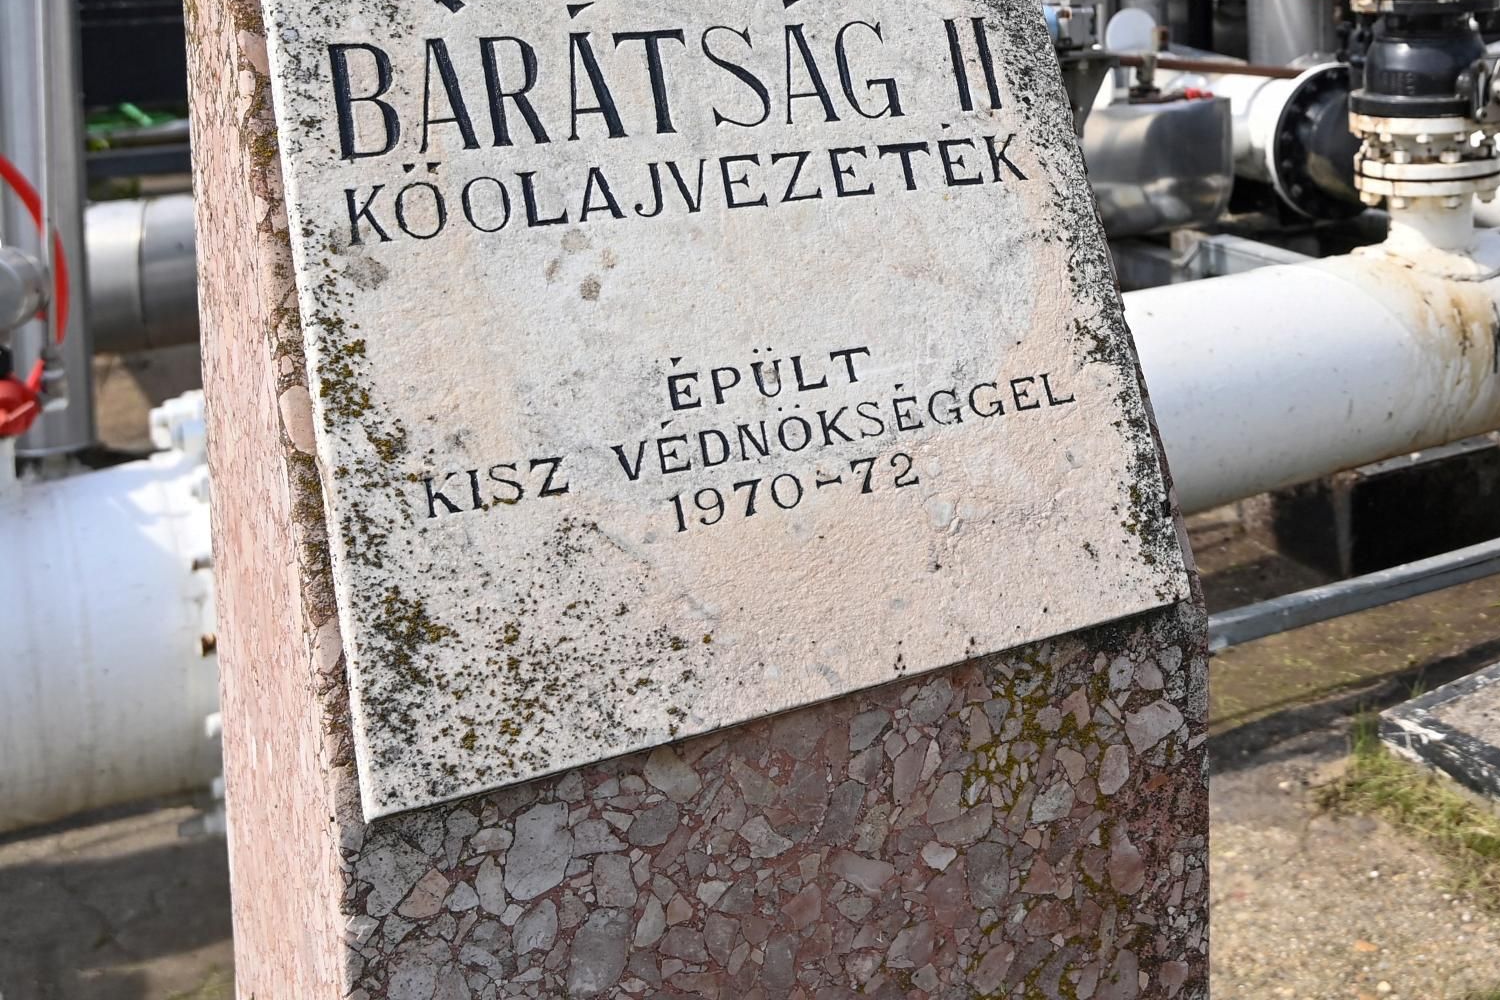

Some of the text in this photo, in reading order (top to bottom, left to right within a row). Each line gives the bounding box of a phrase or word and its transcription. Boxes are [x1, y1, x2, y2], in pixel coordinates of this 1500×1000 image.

[943, 16, 1002, 112] II
[344, 122, 1029, 246] KŐOLAJVEZETÉK
[667, 346, 870, 411] ÉPÜLT
[424, 372, 1076, 519] KISZ VÉDNÖKSÉGGEL
[669, 453, 919, 532] 1970-72
